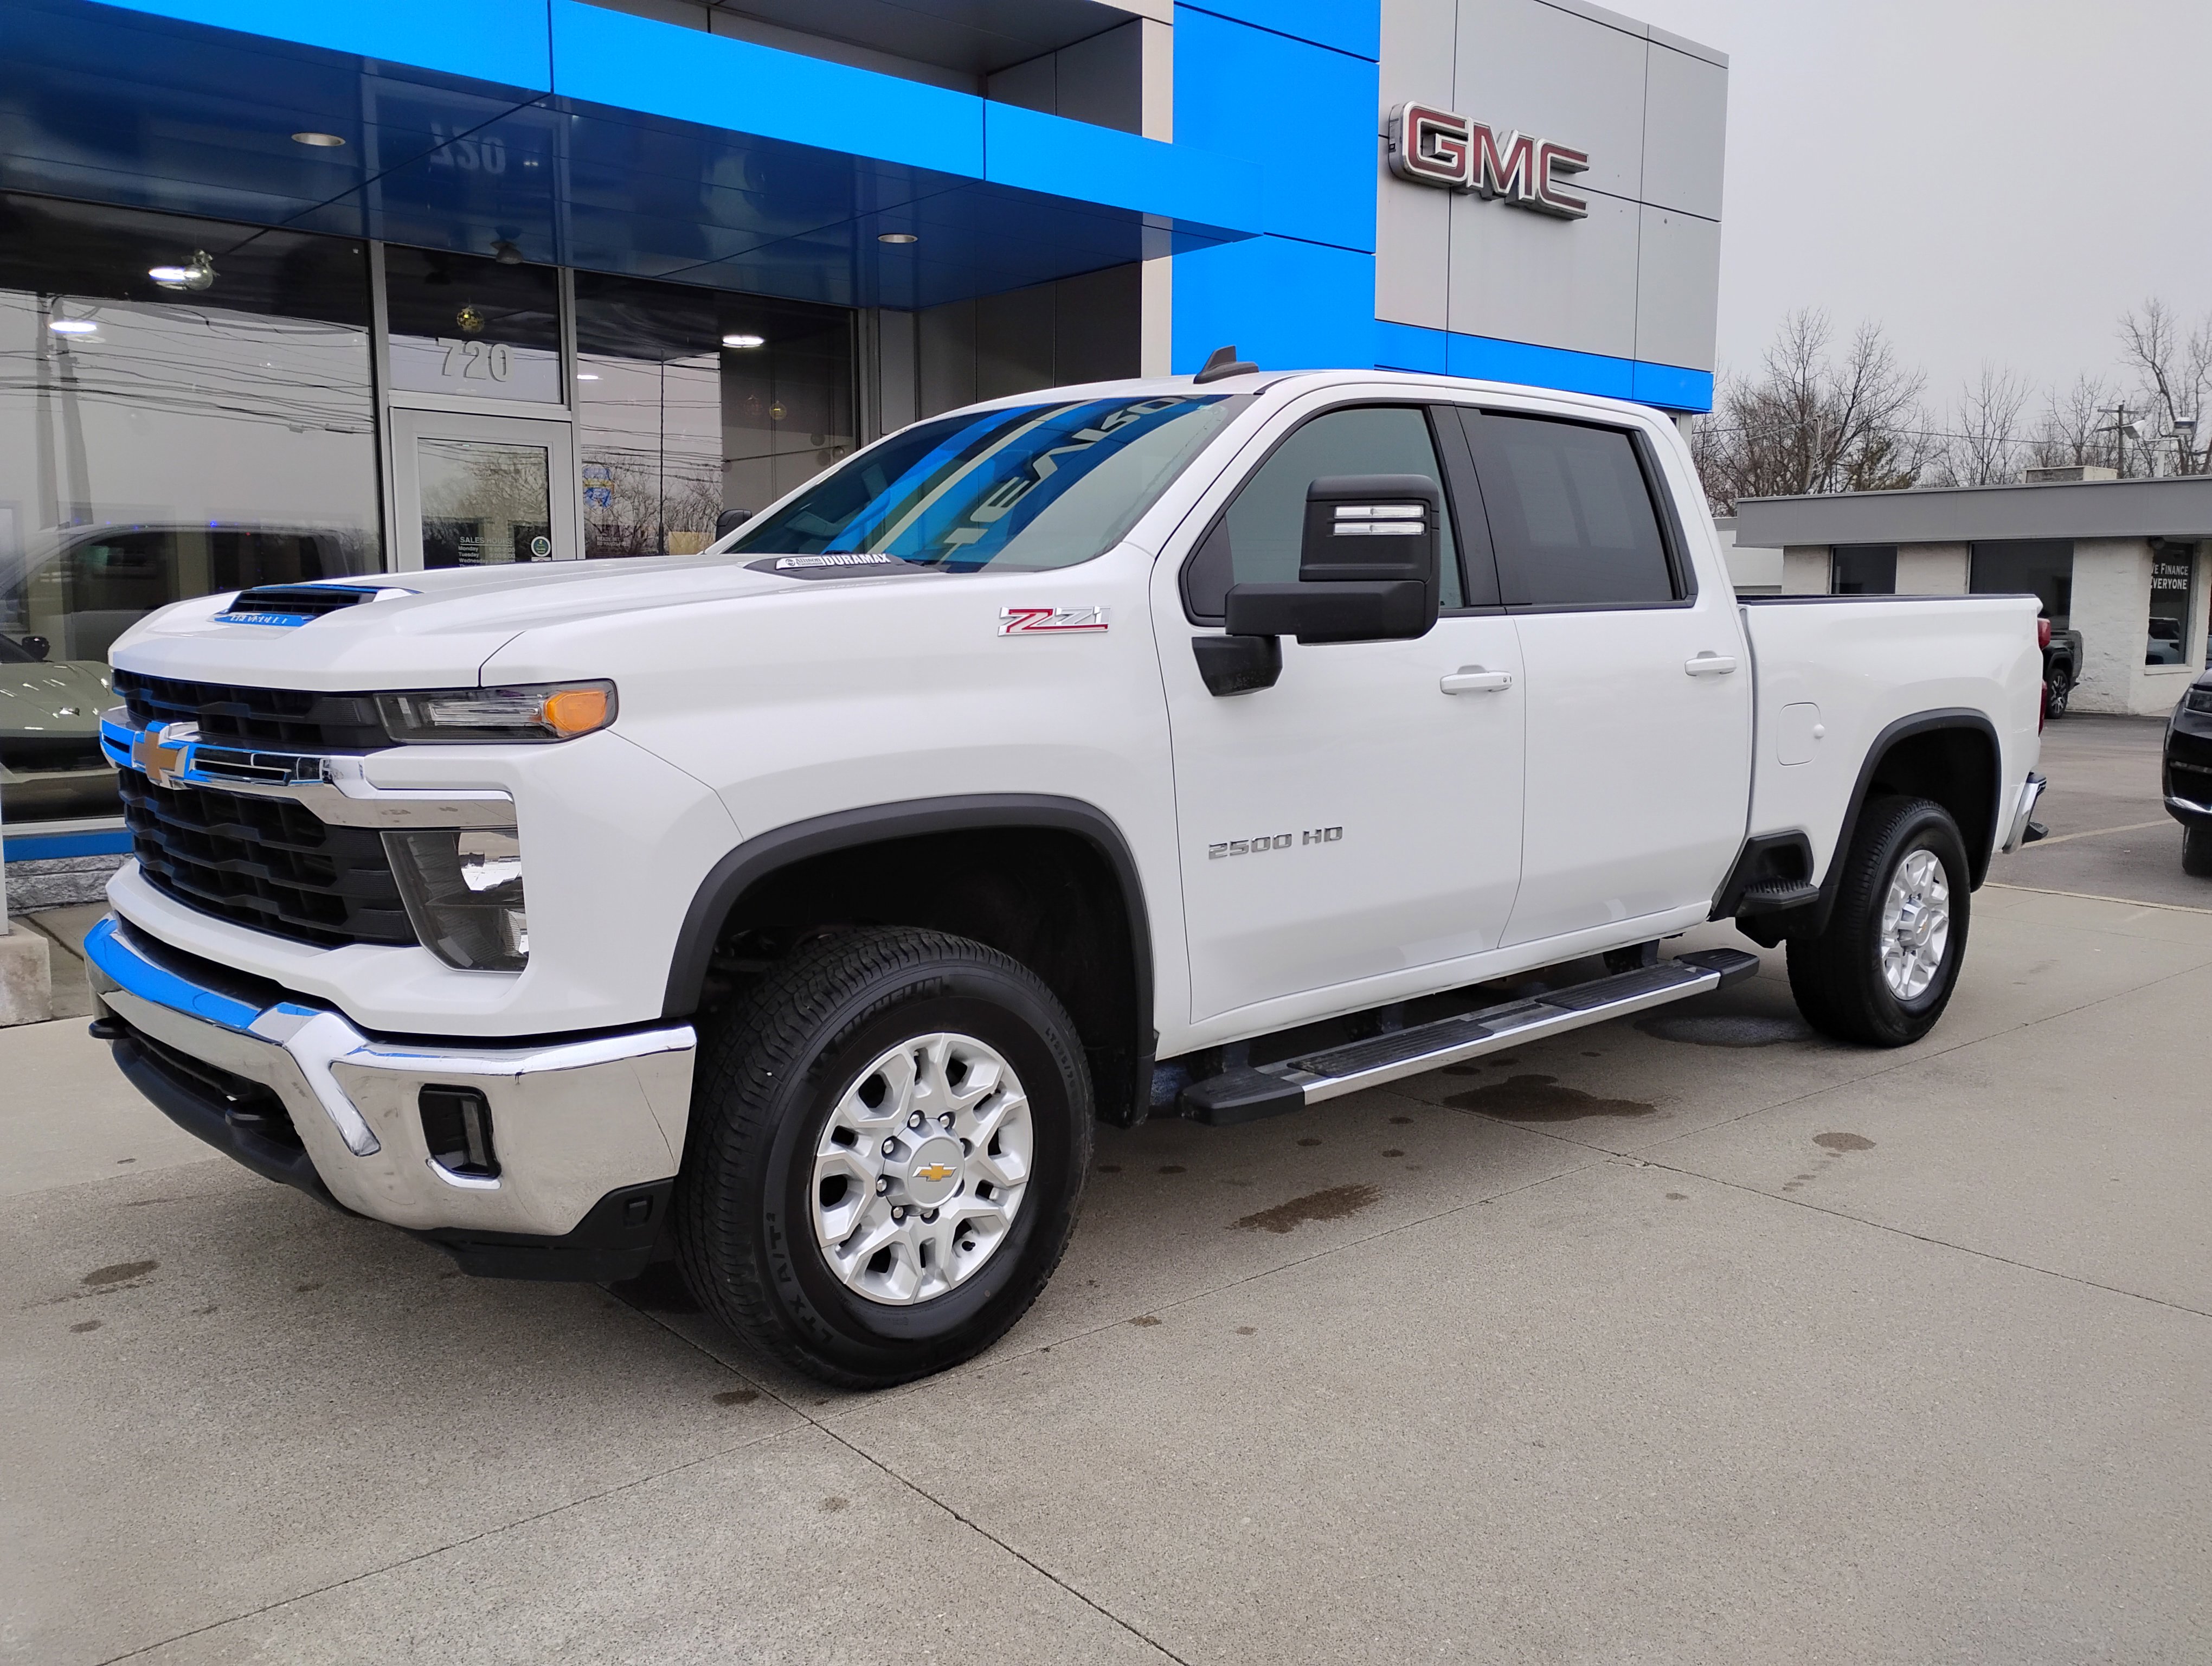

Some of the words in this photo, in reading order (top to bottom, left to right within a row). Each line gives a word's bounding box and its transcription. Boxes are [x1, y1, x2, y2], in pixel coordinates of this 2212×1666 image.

[1398, 101, 1590, 219] GMC
[435, 337, 515, 382] 720
[823, 553, 891, 566] DURAMAX
[2152, 563, 2159, 574] E
[2160, 563, 2189, 575] FINANCE
[2152, 578, 2188, 589] VERYONE
[998, 606, 1111, 637] Z71
[1208, 833, 1293, 860] 2500
[1302, 826, 1343, 845] HD
[835, 976, 943, 1047] MICHELIN
[789, 1293, 834, 1344] LTX
